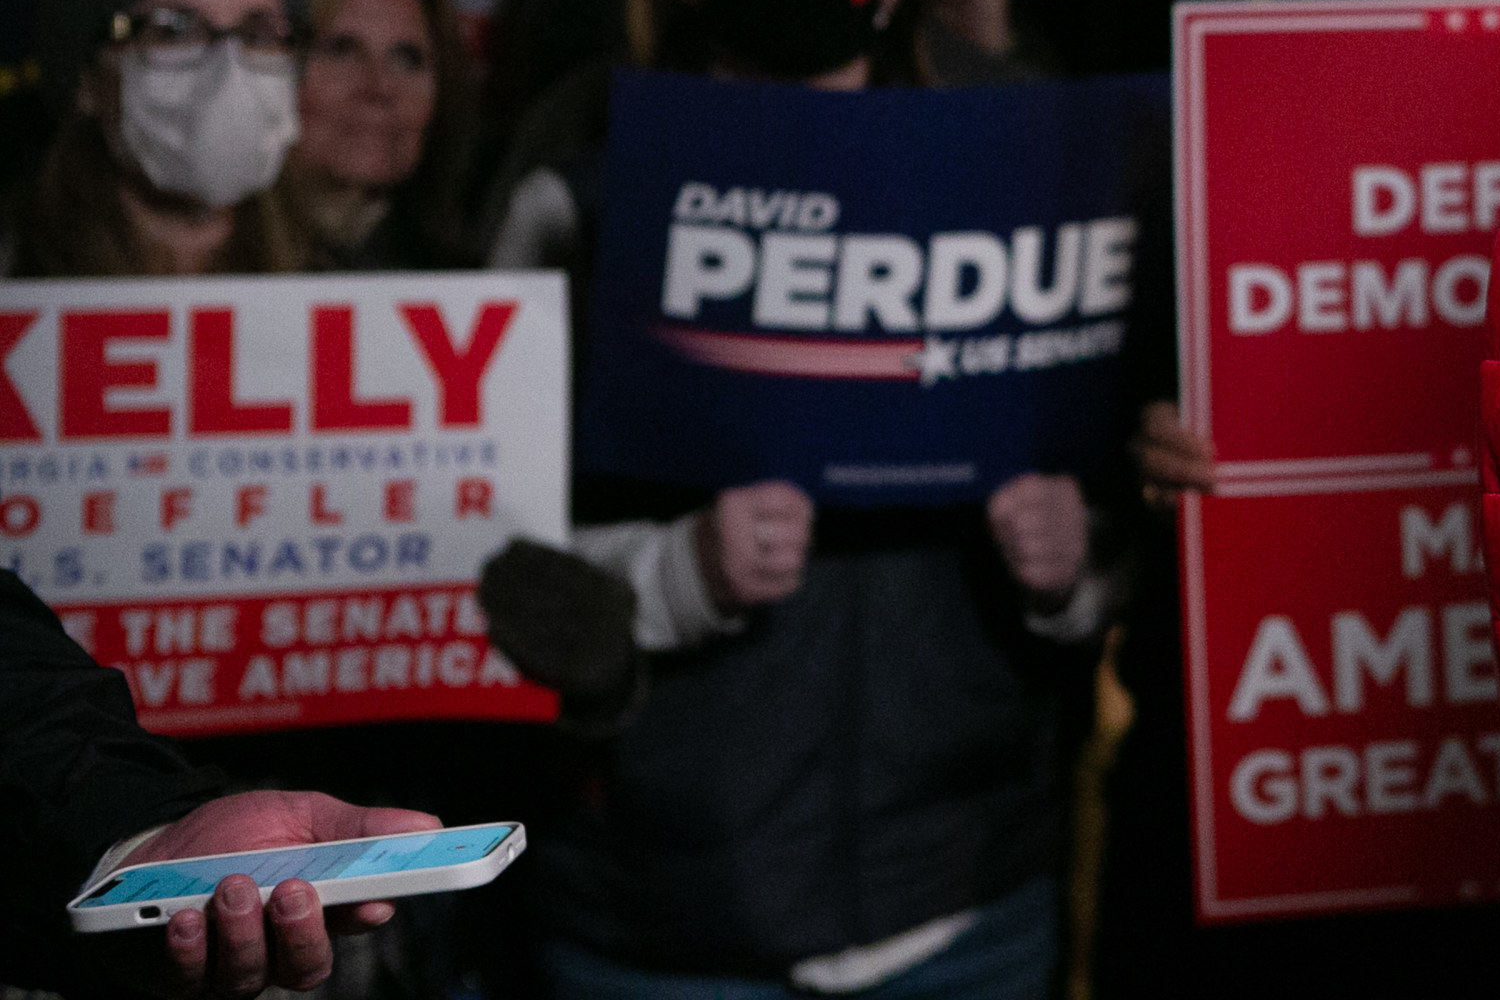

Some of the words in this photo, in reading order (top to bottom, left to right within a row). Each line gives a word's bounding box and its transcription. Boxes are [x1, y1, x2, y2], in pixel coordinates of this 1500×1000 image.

[672, 181, 843, 233] DAVID
[660, 214, 1139, 334] PERDUE
[140, 531, 432, 585] SENATOR
[118, 605, 238, 656] THE
[236, 641, 521, 702] AMERICA
